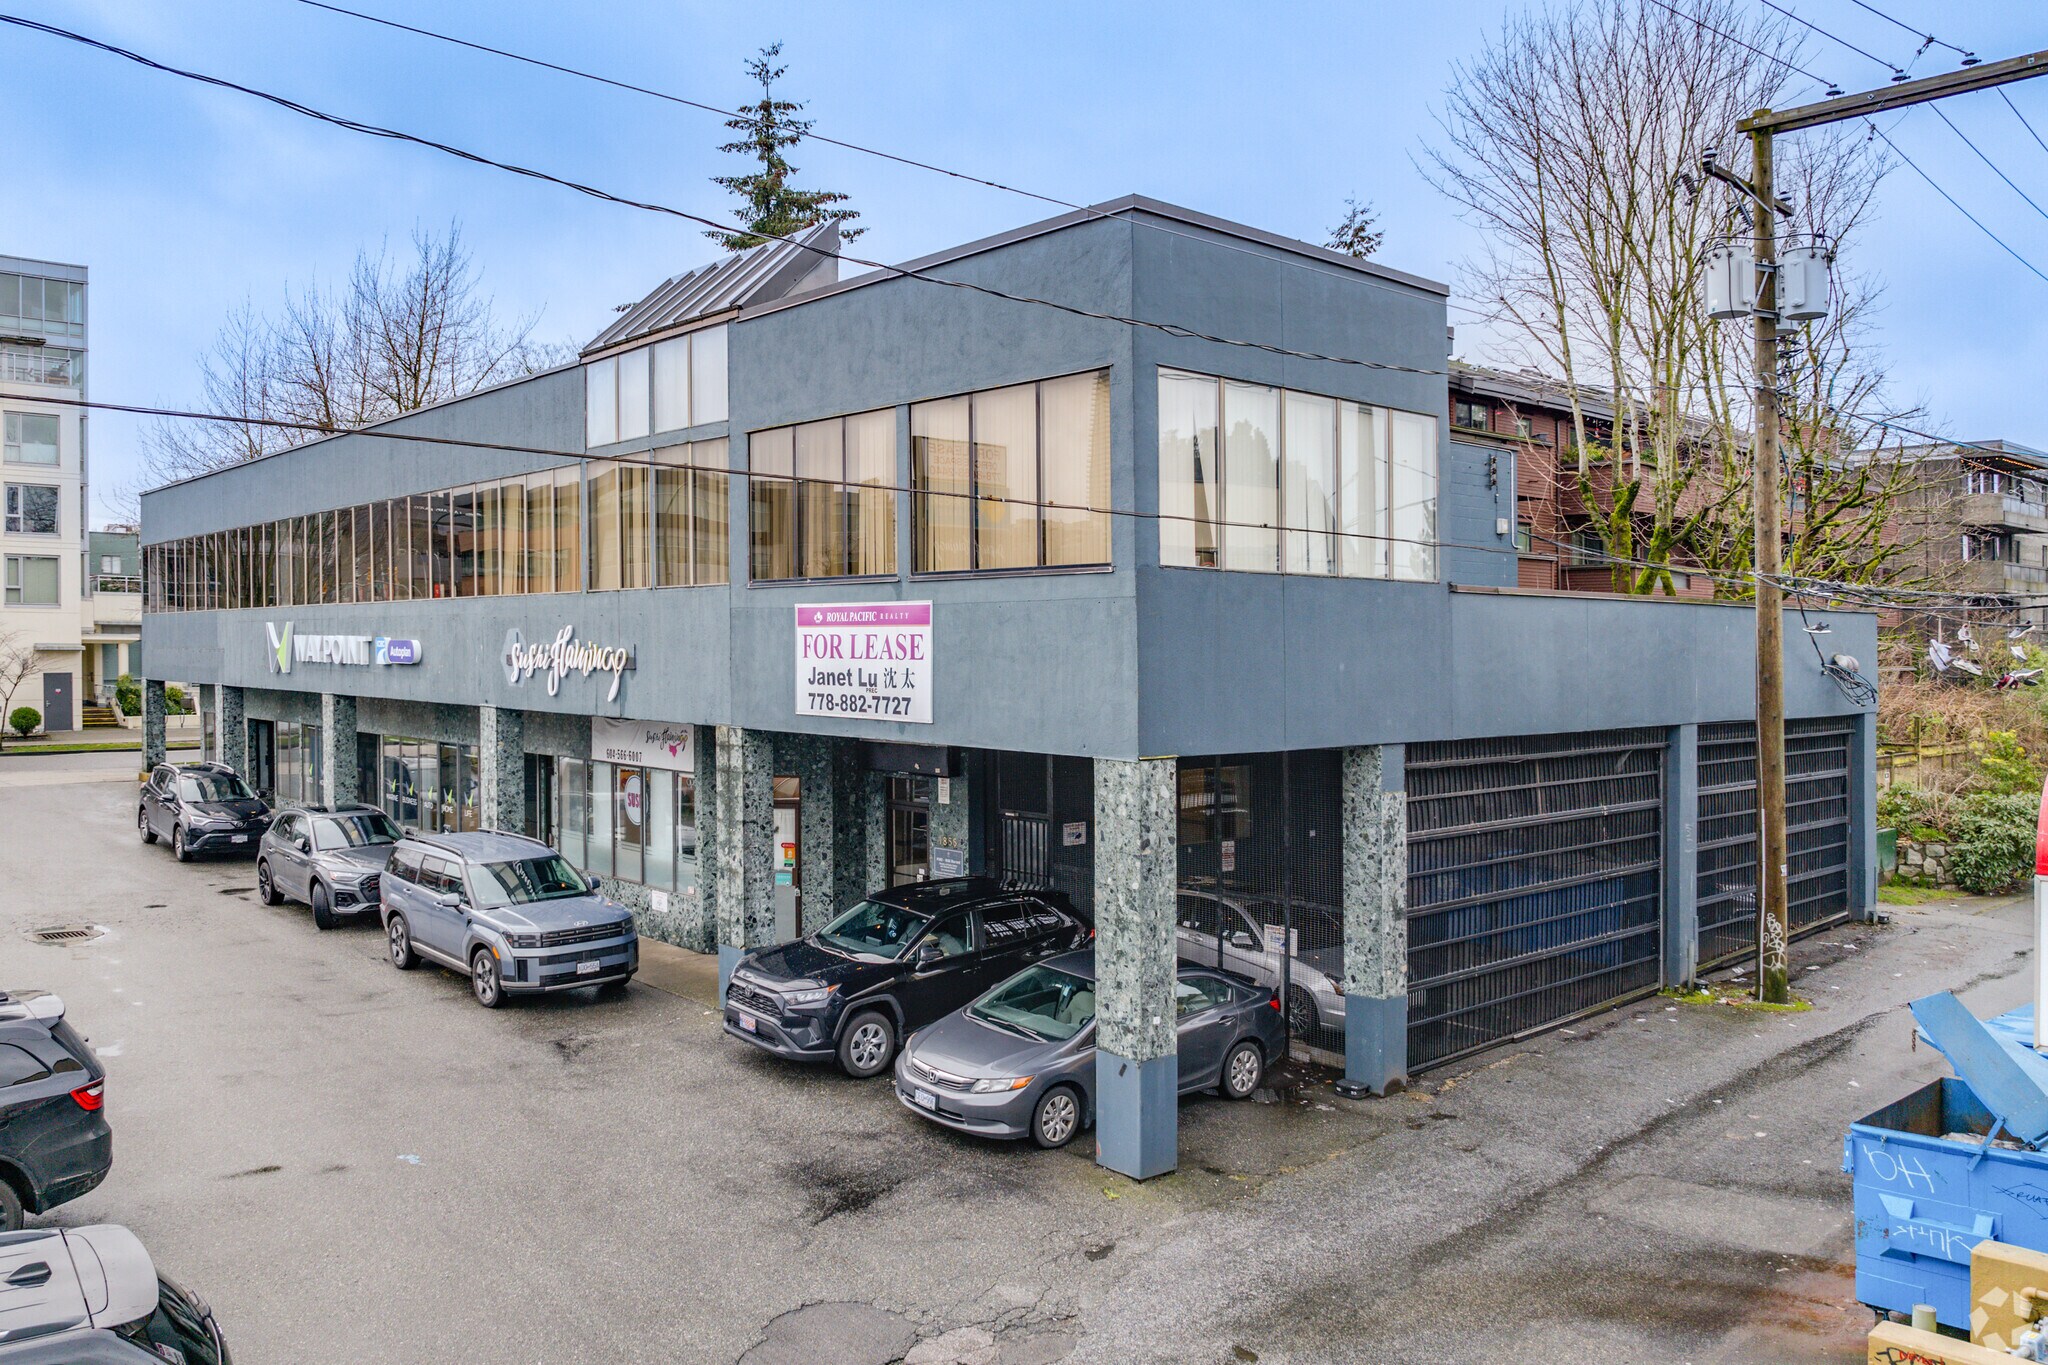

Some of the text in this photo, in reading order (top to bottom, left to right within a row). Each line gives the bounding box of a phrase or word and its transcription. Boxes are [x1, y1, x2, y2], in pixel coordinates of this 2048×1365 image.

[826, 611, 909, 622] ROYAL PACIFIC REALTY
[293, 634, 373, 665] WAYPOINT
[390, 646, 411, 659] Autoplan
[802, 633, 925, 661] FOR LEASE
[808, 666, 878, 688] Janet Lu
[808, 692, 912, 716] 778-882-7727
[627, 792, 641, 809] SUS
